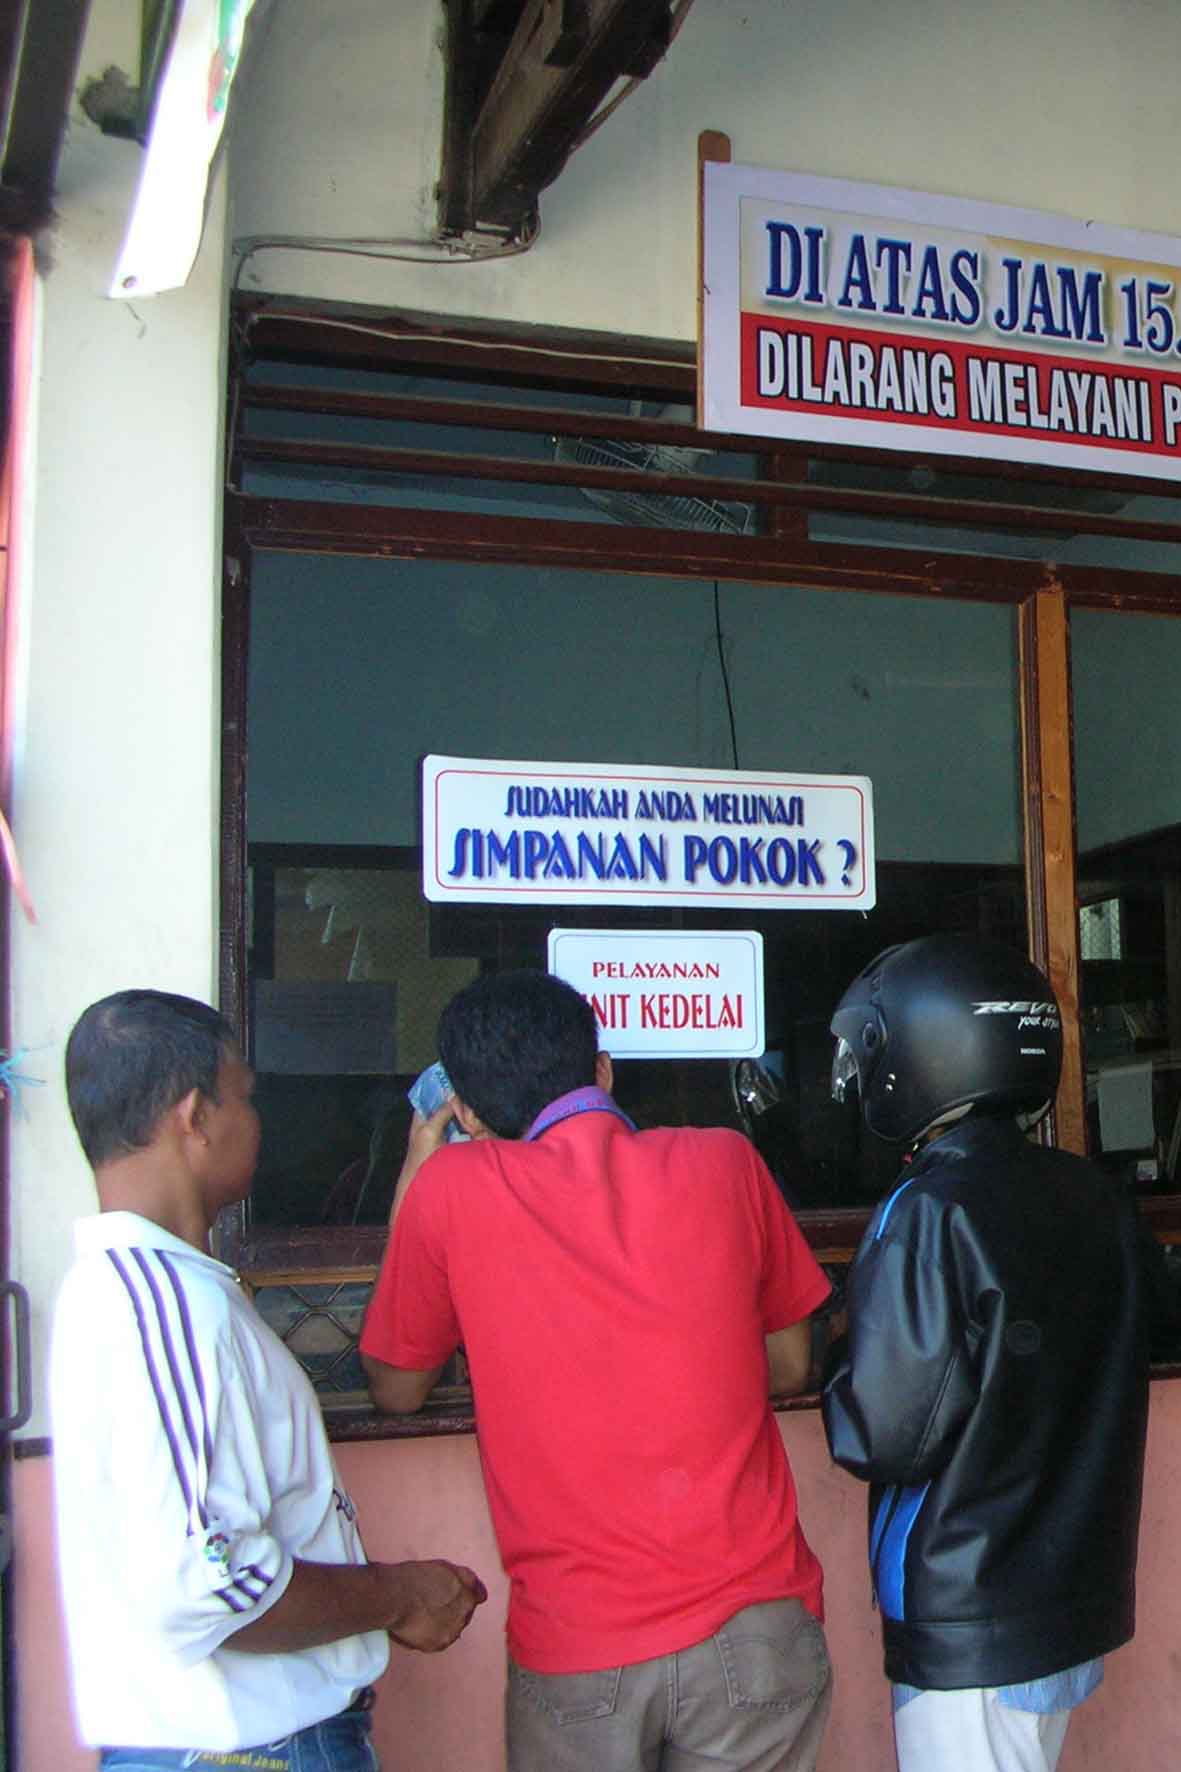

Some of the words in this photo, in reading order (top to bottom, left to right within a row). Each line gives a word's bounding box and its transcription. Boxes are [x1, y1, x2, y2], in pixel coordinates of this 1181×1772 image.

[766, 219, 824, 304] DI
[838, 233, 981, 327] ATAS
[994, 257, 1104, 344] JAM
[758, 329, 954, 420] DILARANG
[967, 358, 1153, 443] MELAYANI
[504, 785, 628, 820] SUDAHKAH
[634, 789, 696, 822] ANDA
[702, 792, 804, 827] MELUNASI
[447, 828, 668, 885] SIMPANAN
[684, 834, 826, 886] POKOK
[836, 838, 858, 887] ?
[592, 961, 721, 979] PELAYANAN
[579, 993, 631, 1030] NIT
[640, 993, 743, 1030] KEDELAI
